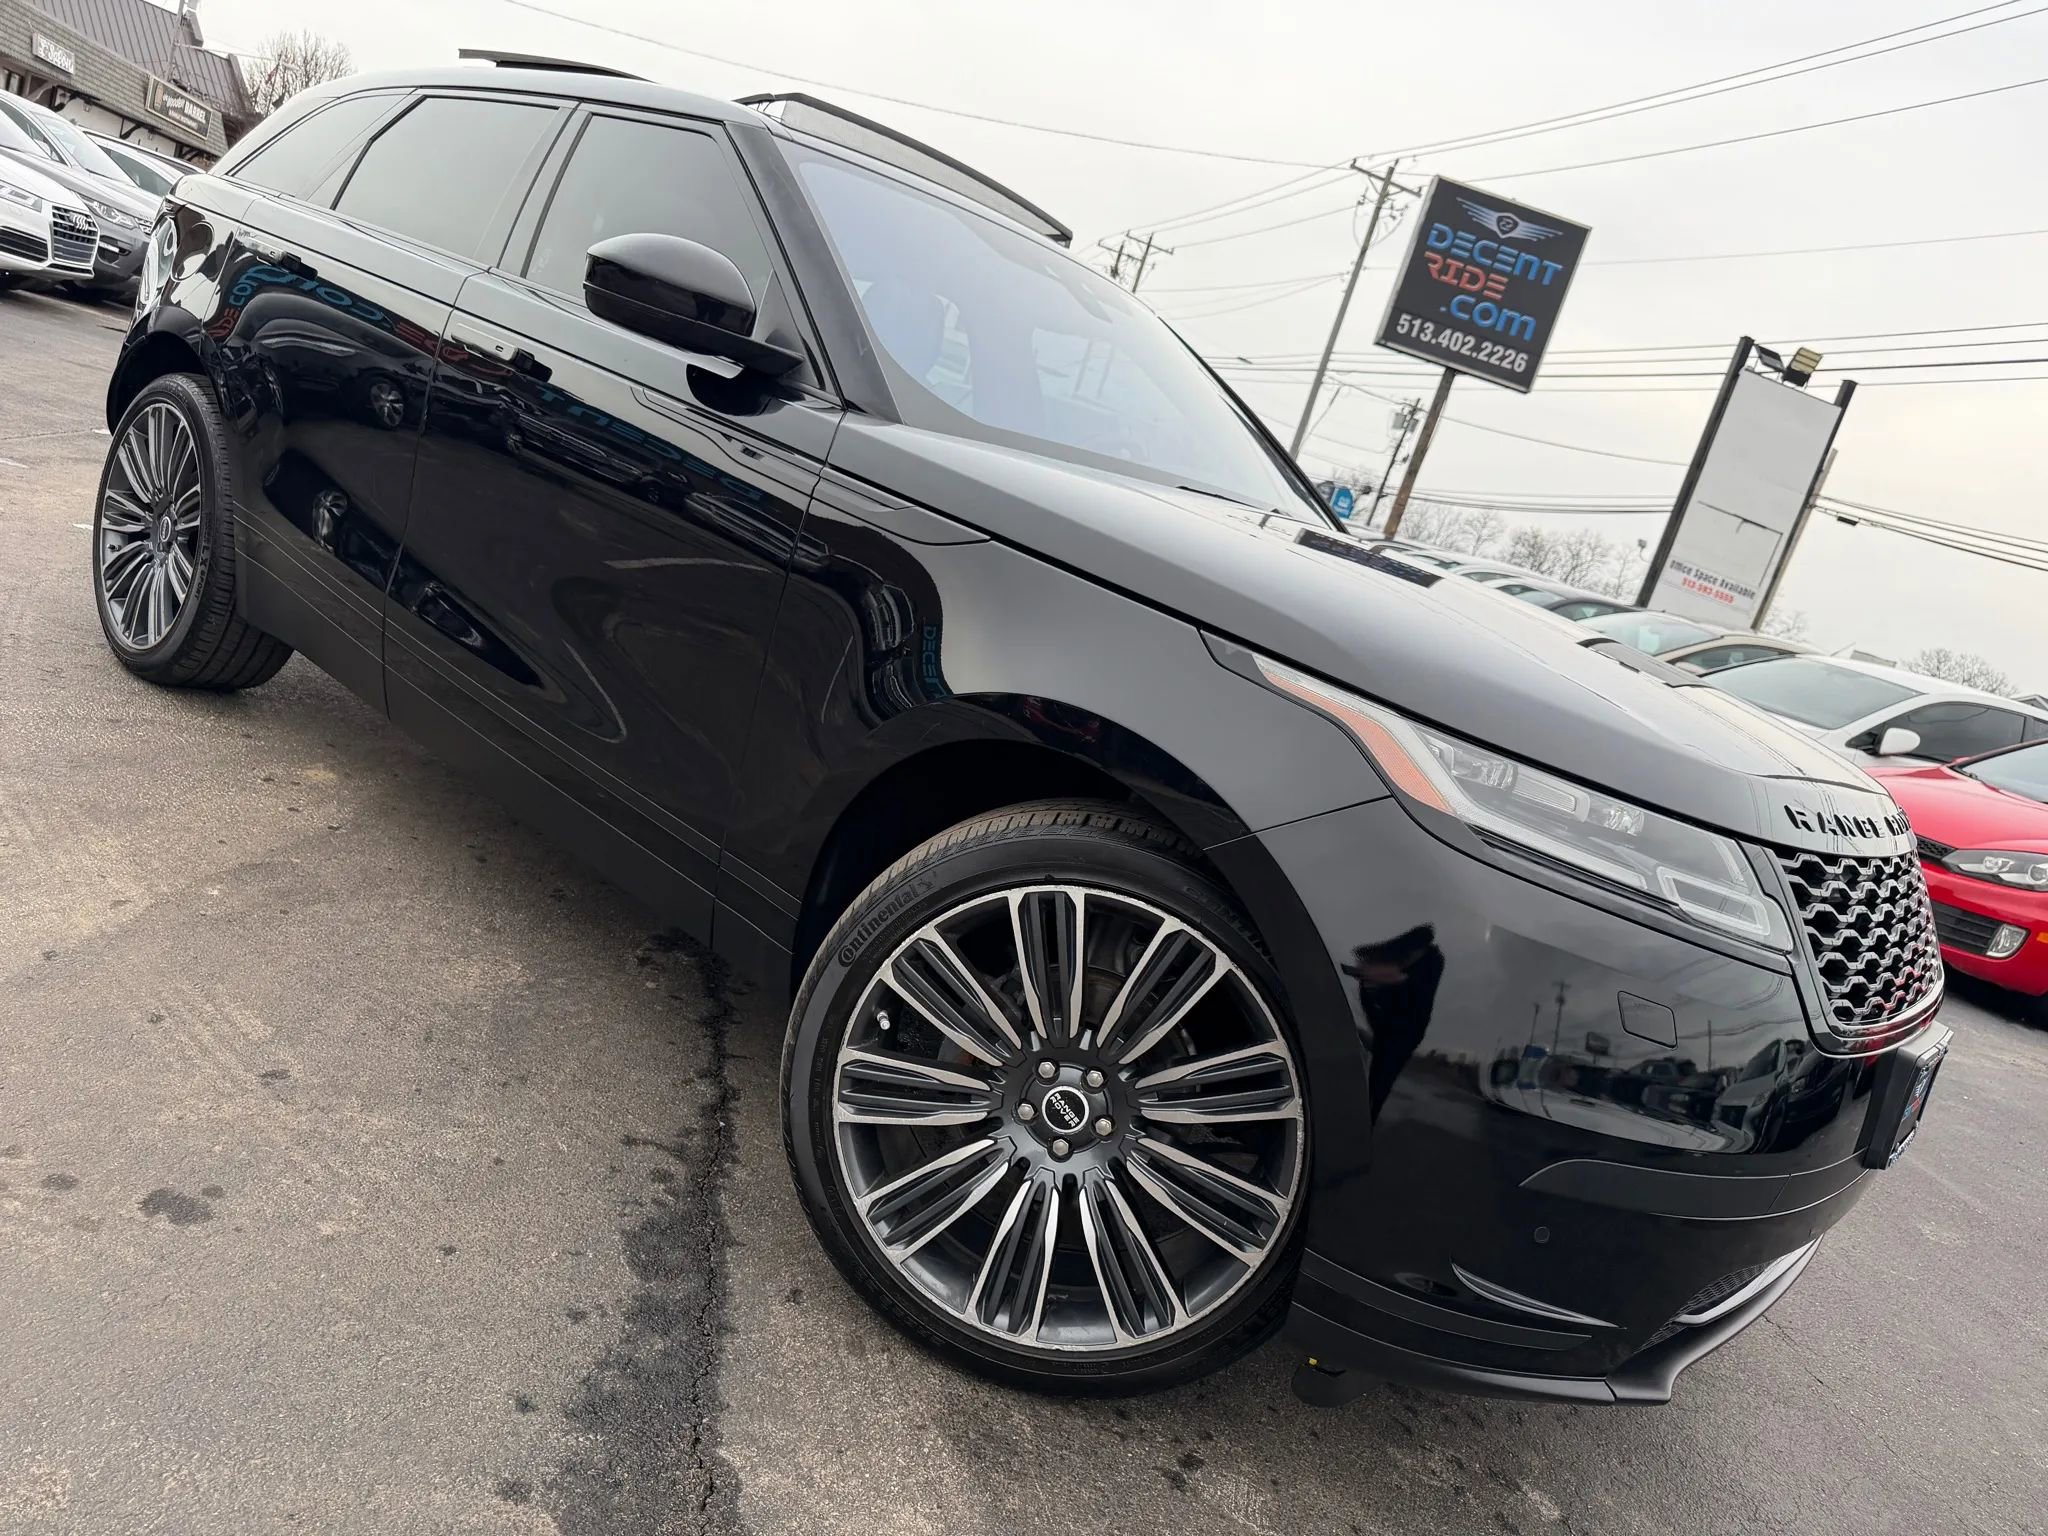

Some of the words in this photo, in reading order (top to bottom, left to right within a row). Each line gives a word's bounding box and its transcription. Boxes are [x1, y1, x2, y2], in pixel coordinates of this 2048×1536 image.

[1427, 222, 1563, 285] DECENT
[1424, 251, 1509, 301] RIDE
[1396, 312, 1529, 373] 513.402.2226
[1693, 568, 1718, 586] Space
[1719, 578, 1756, 600] Available
[1050, 1096, 1076, 1128] ROVER
[1053, 1092, 1080, 1123] RANGE
